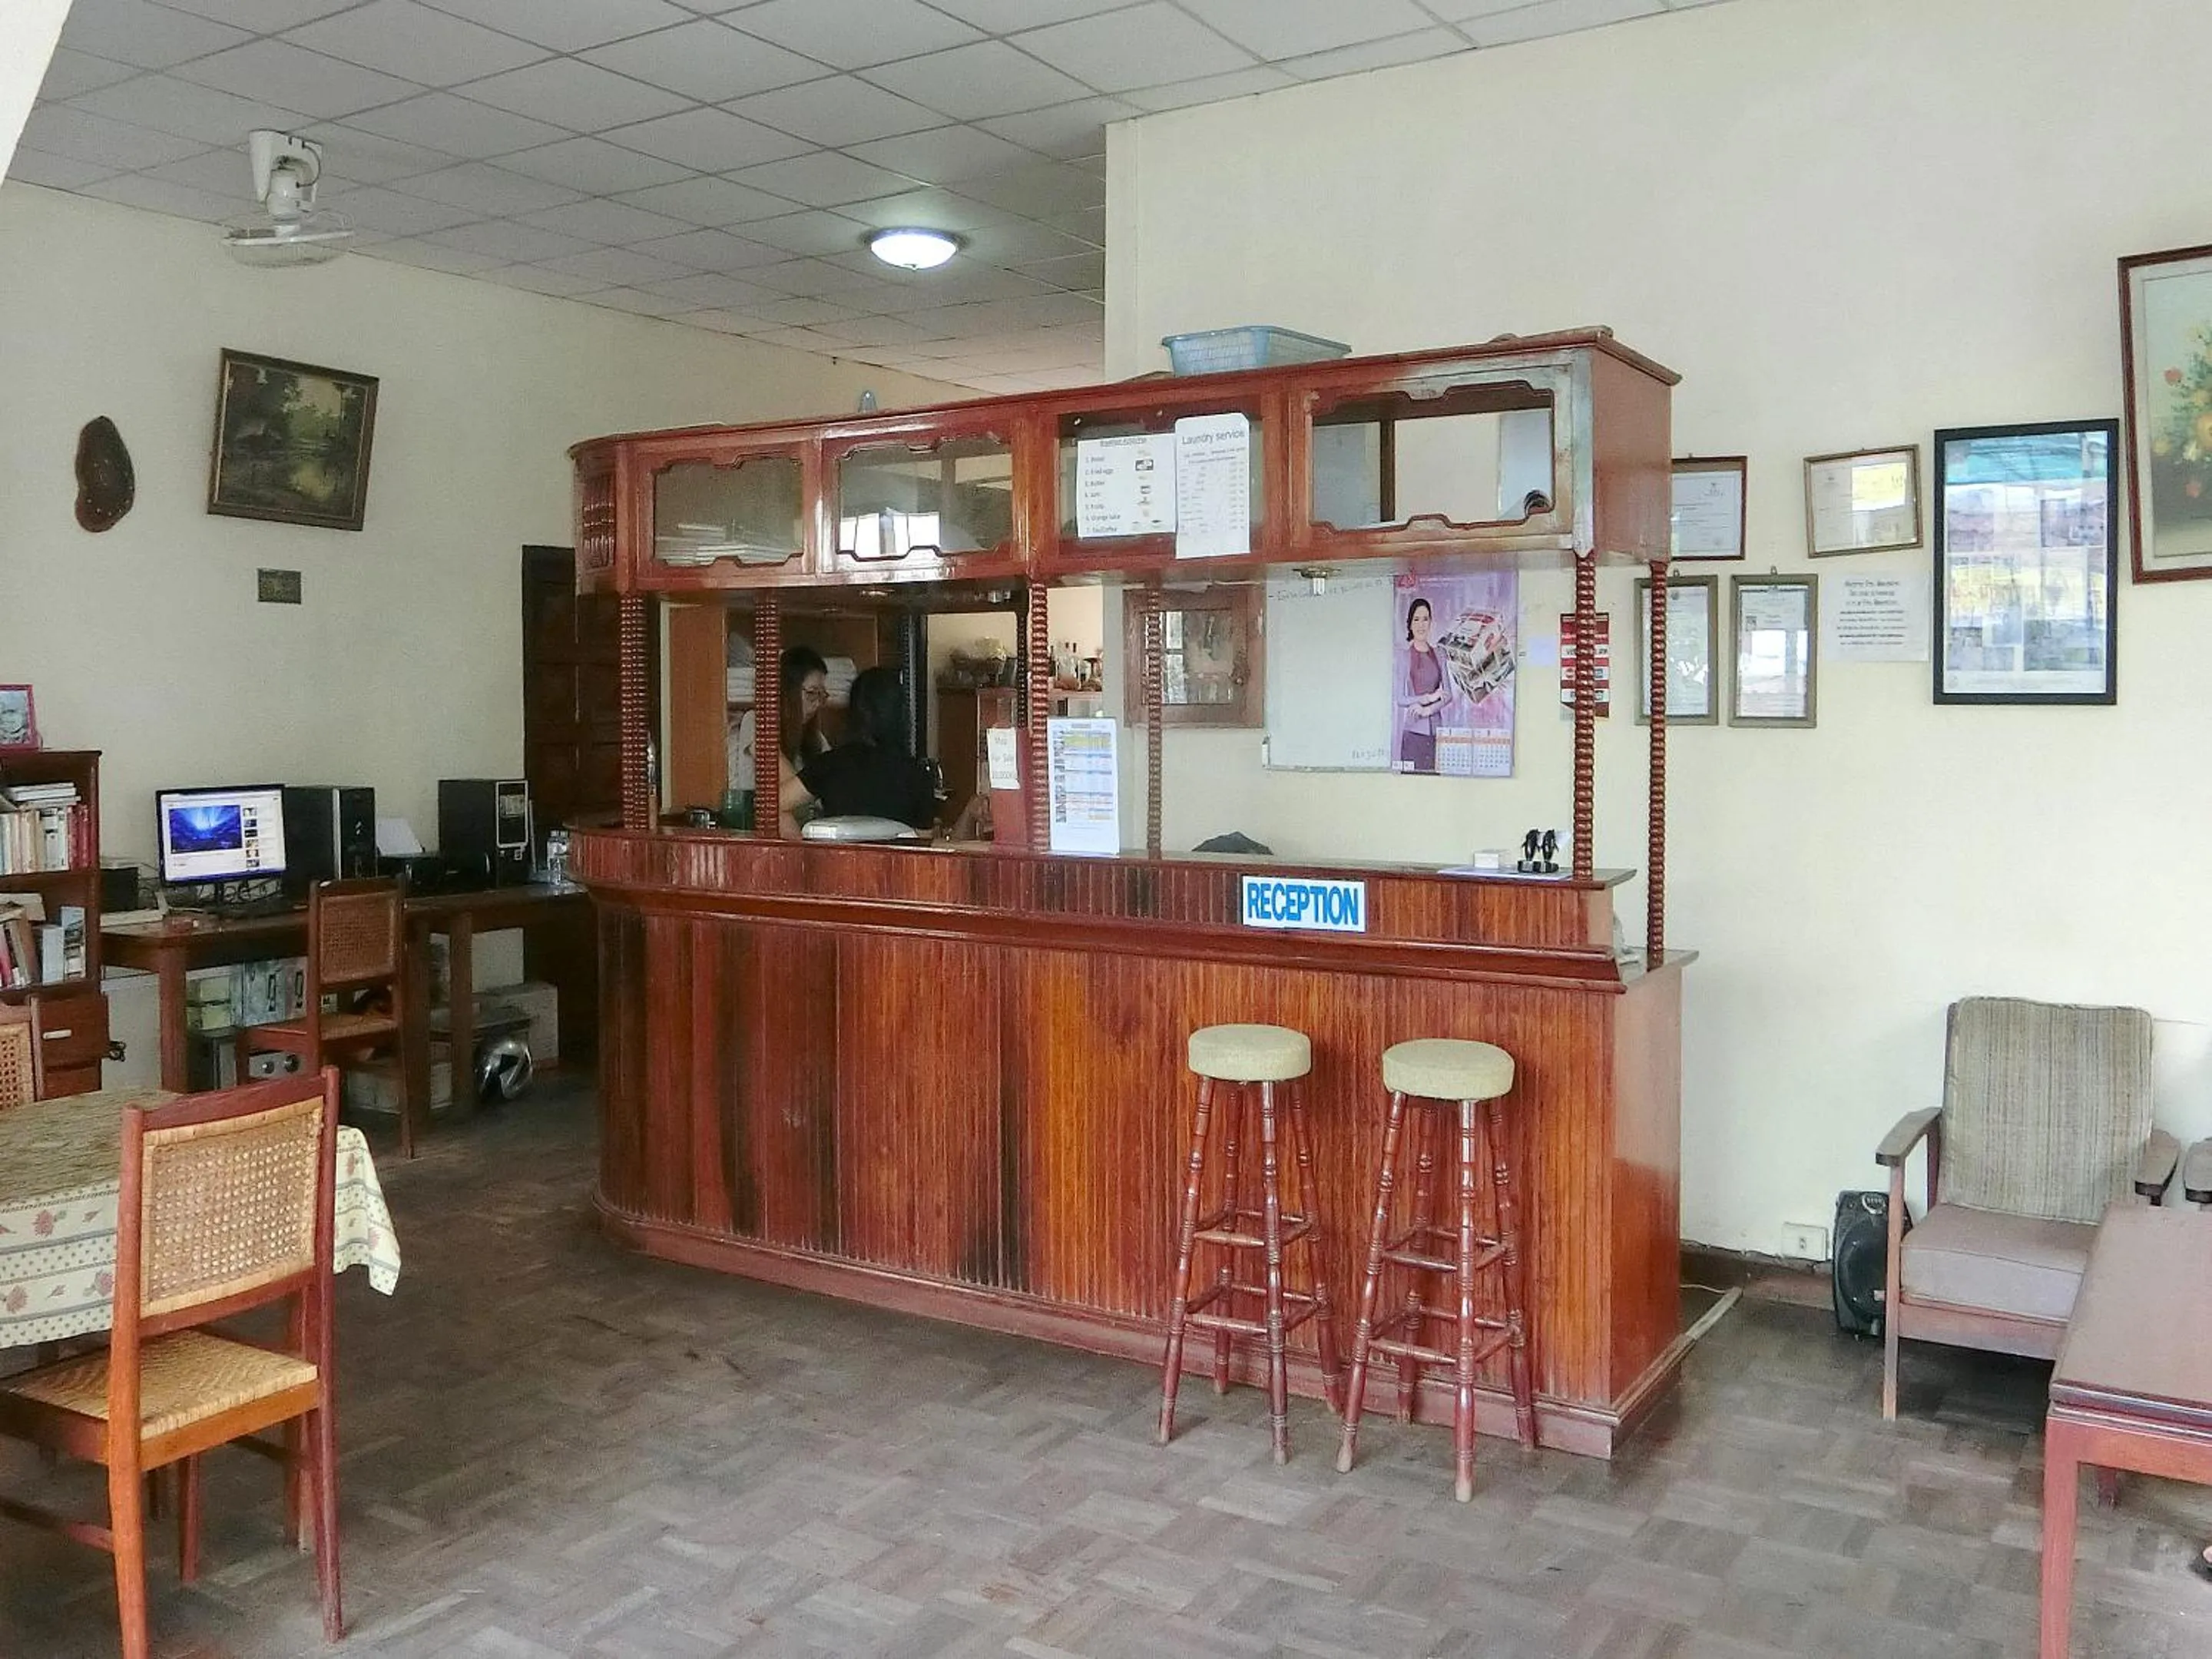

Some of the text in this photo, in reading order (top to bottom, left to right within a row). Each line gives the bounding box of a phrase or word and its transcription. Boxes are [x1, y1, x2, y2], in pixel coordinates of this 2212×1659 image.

[1182, 430, 1245, 445] Laundry service
[1247, 882, 1359, 926] RECEPTION
